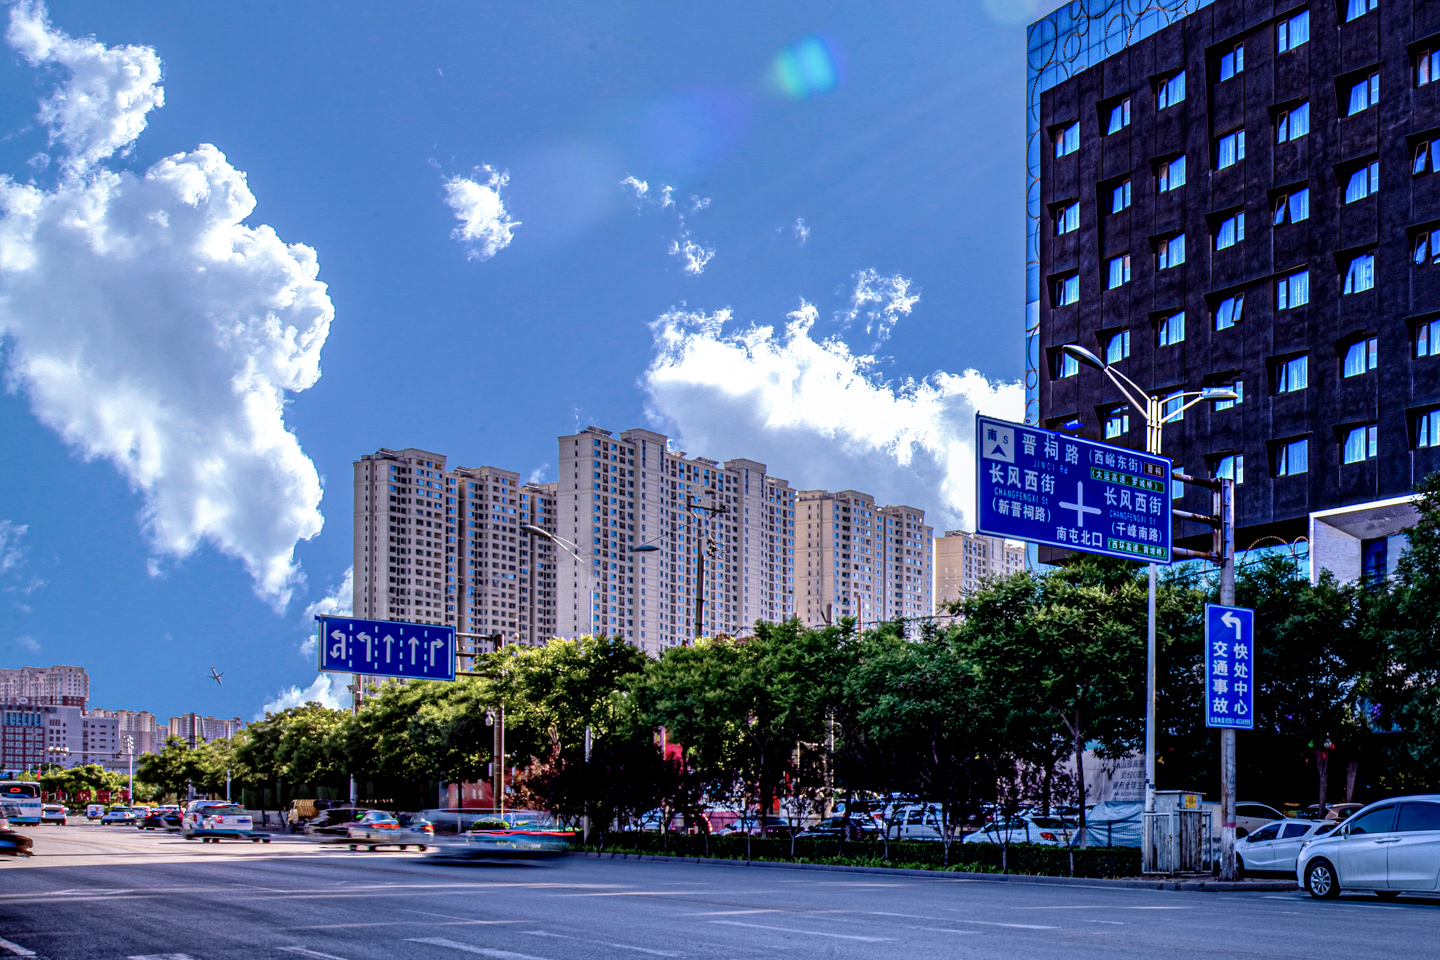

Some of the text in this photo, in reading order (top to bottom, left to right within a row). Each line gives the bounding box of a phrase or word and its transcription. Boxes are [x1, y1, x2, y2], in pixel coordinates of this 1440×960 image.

[987, 428, 1009, 445] 南 S
[1022, 432, 1079, 465] 晋祠路
[989, 462, 1056, 495] 长风西街
[1033, 460, 1068, 475] JINCI Rd
[994, 486, 1048, 505] CHANGFENGXI St
[1104, 486, 1162, 517] 长风西街
[1109, 509, 1156, 526] CHANGFENGXI St
[1056, 525, 1103, 548] 南屯北口
[1212, 641, 1229, 715] 交通事故
[1233, 642, 1249, 716] 快处中心
